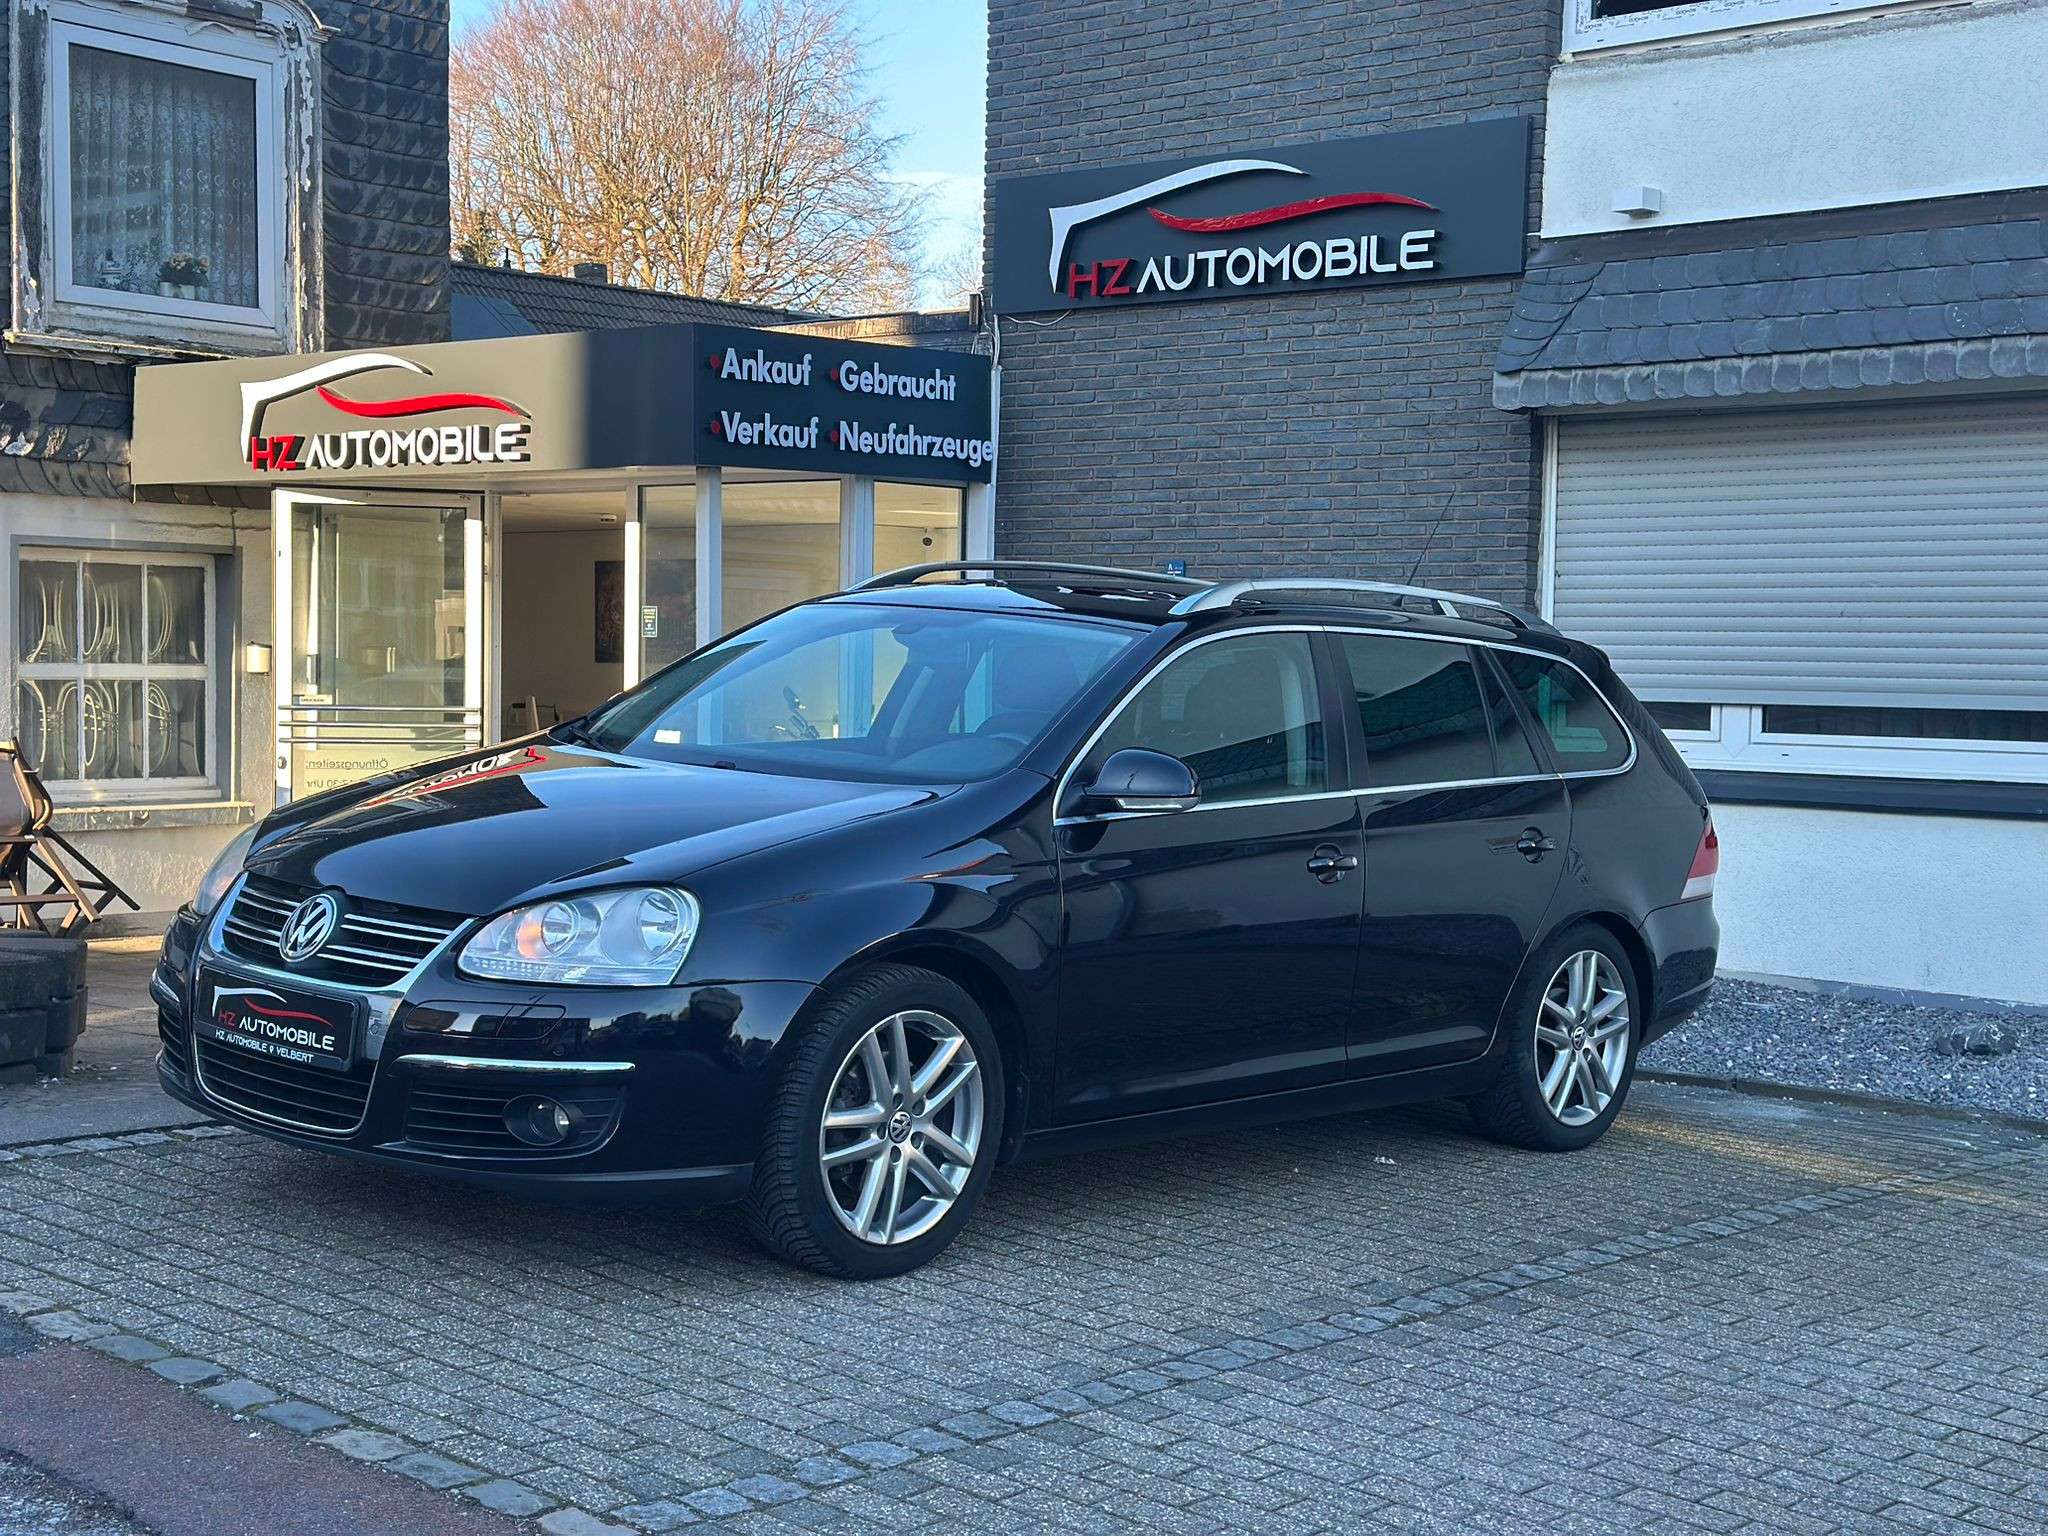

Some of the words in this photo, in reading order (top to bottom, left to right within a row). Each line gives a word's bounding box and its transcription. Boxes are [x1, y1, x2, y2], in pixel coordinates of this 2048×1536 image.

[1068, 258, 1131, 299] HZ
[1136, 229, 1436, 294] AUTOMOBILE
[720, 347, 812, 386] Ankauf
[839, 360, 957, 401] Gebraucht
[252, 434, 302, 472] HZ
[305, 422, 526, 469] AUTOMOBILE
[720, 410, 820, 449] Verkauf
[839, 420, 995, 468] Neufahrzeuge
[215, 1029, 225, 1040] HZ
[226, 1034, 267, 1052] AUTOMOBILE
[276, 1046, 314, 1063] VELBERT
[218, 1009, 236, 1027] HZ
[239, 1016, 335, 1051] AUTOMOBILE
